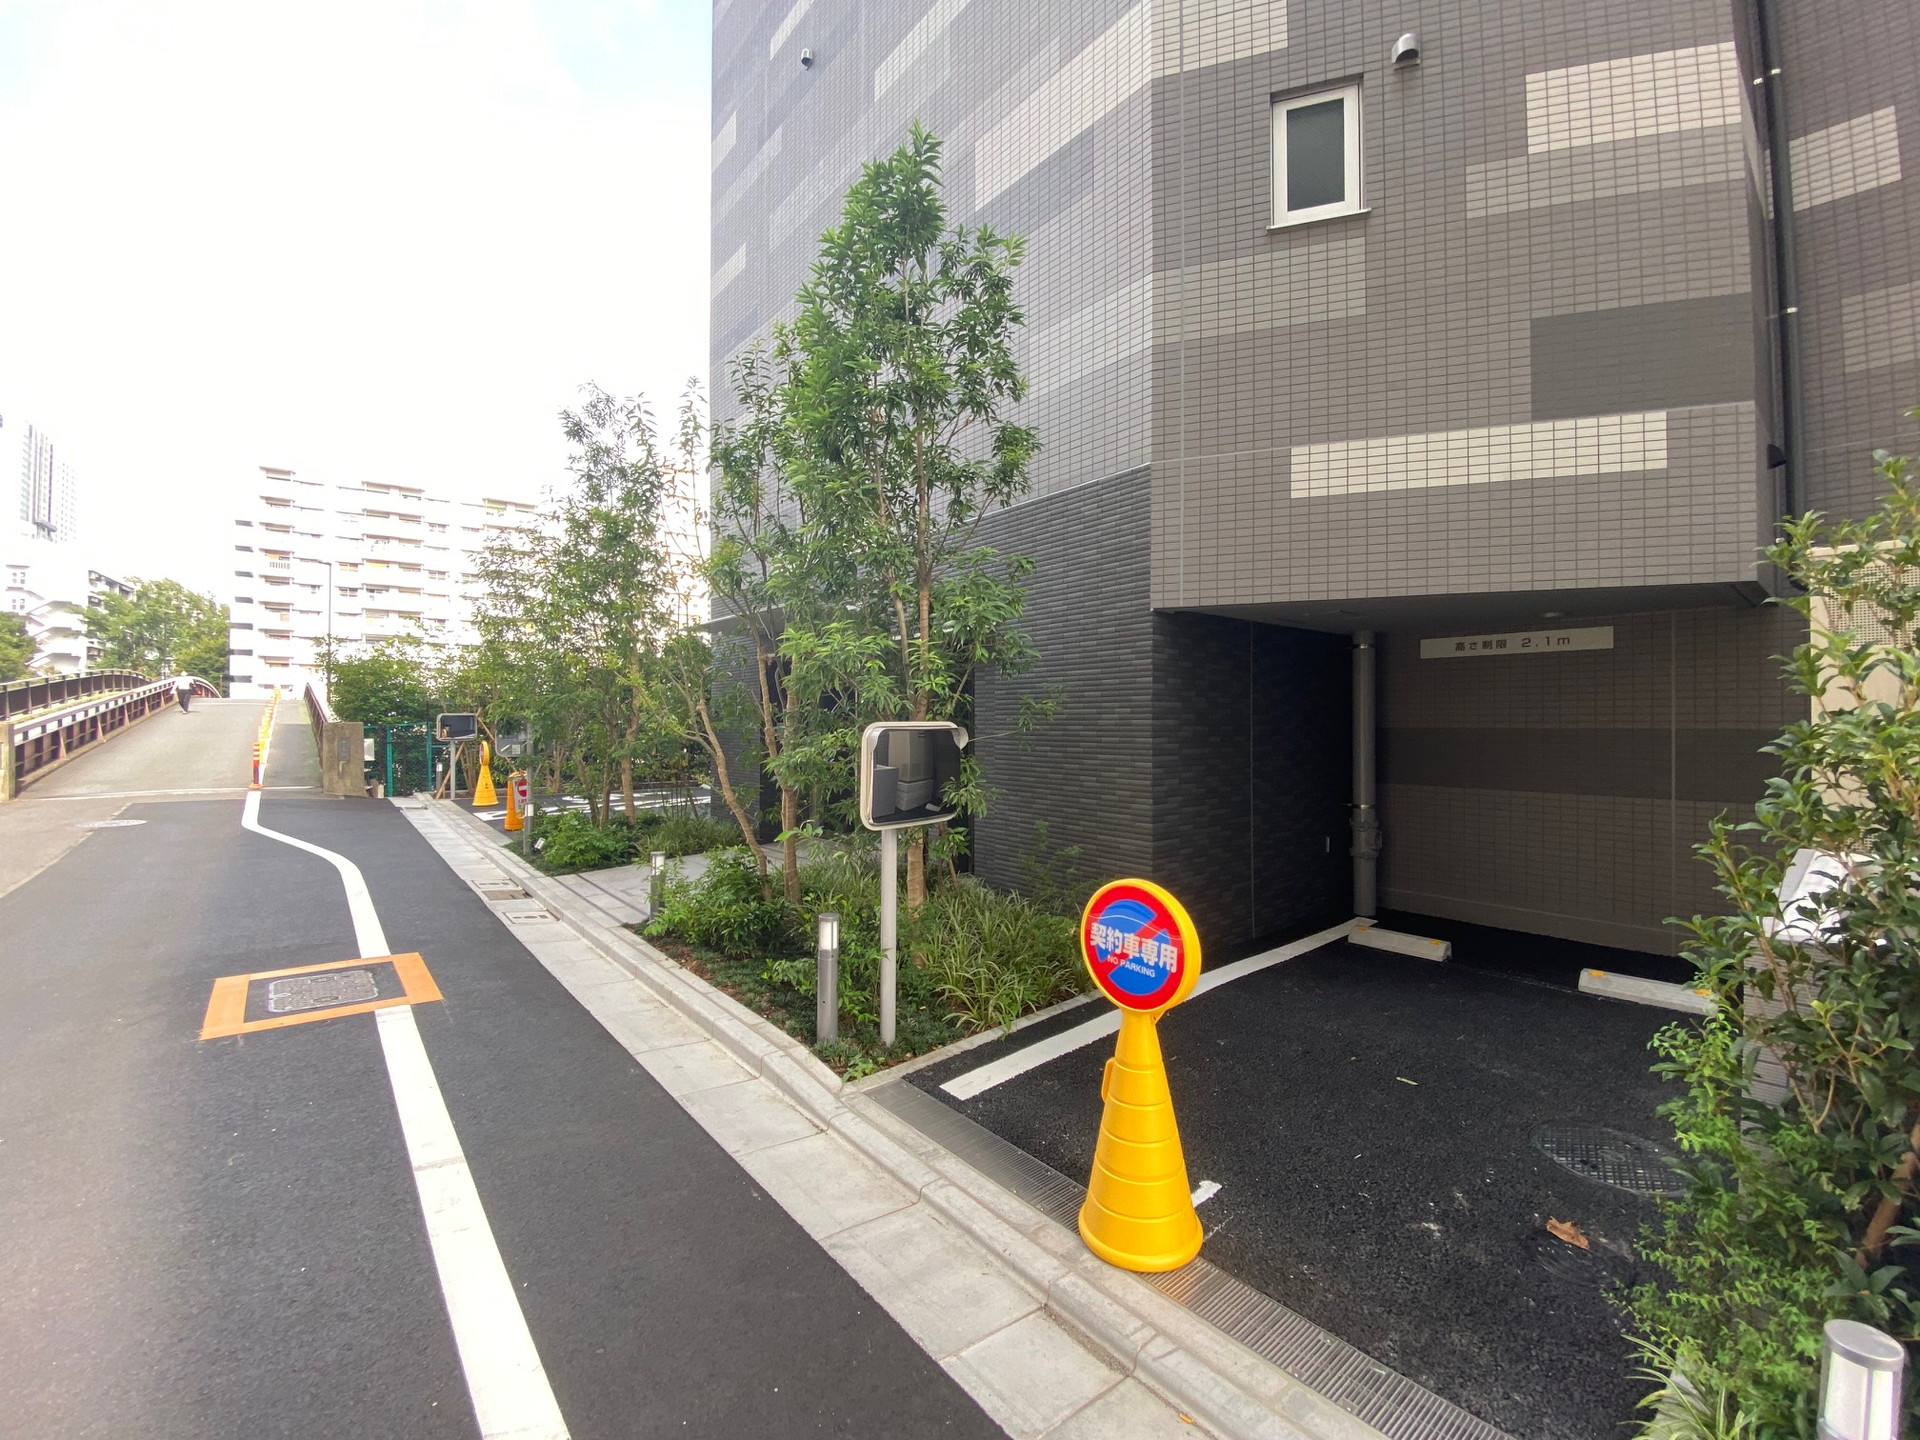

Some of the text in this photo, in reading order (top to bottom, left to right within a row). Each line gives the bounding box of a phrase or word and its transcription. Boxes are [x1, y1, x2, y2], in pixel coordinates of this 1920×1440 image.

[1455, 636, 1571, 652] 高さ制限 2.1m
[1090, 922, 1178, 973] 契約車専用
[1107, 954, 1156, 978] NO PARKING
